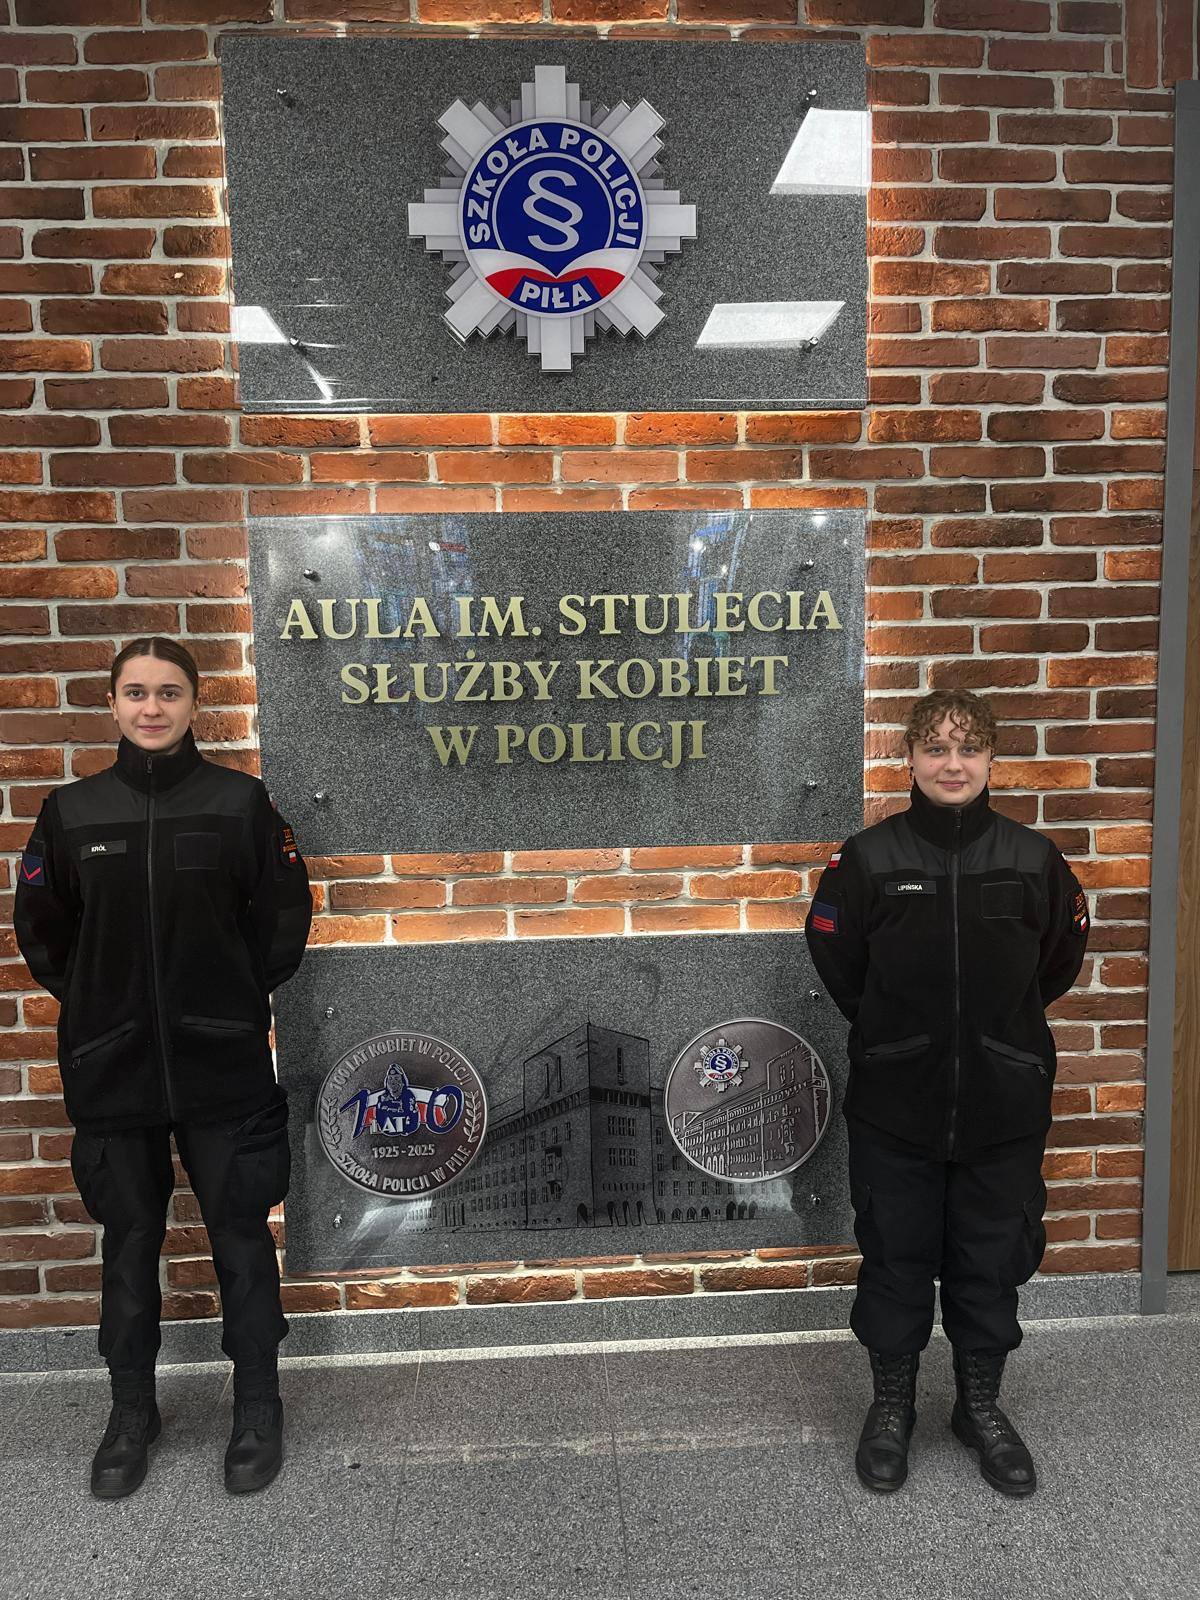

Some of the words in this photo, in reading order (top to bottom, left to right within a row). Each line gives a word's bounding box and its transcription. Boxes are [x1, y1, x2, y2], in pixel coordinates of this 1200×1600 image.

[467, 127, 549, 243] SZKOŁA
[559, 127, 640, 246] POLICJI
[519, 283, 592, 309] PIŁA
[279, 597, 440, 640] AULA
[455, 596, 542, 637] IM.
[558, 590, 843, 636] STULECIA
[340, 650, 561, 704] SŁUŻBY
[576, 655, 789, 700] KOBIET
[425, 725, 480, 766] W
[494, 720, 707, 769] POLICJI
[331, 1068, 351, 1091] 100
[345, 1049, 370, 1072] LAT
[368, 1038, 417, 1058] KOBIET
[418, 1040, 433, 1055] W
[431, 1046, 473, 1086] POLICJI
[369, 1116, 406, 1135] LAT
[338, 1153, 379, 1187] SZKOŁA
[382, 1174, 431, 1192] POLICJI
[430, 1167, 447, 1183] W
[445, 1145, 472, 1173] PILE
